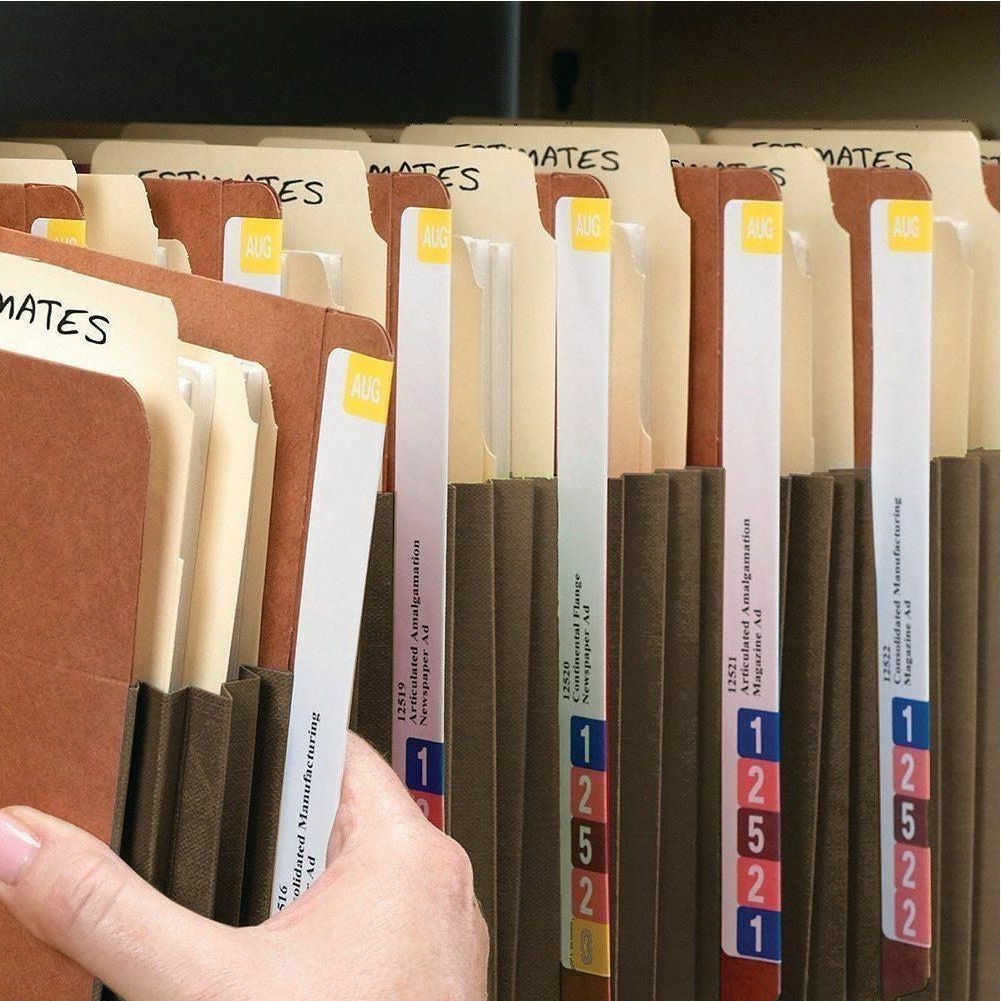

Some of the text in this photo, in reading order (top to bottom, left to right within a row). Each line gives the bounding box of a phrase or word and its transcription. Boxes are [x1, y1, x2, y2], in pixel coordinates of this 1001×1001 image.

[245, 235, 272, 259] AUG
[423, 226, 450, 249] AUG
[576, 214, 601, 237] AUG
[747, 217, 774, 239] AUG
[893, 216, 920, 238] AUG
[350, 372, 382, 405] AUG
[740, 518, 751, 695] Articulated Amalgamation
[892, 498, 902, 685] Consolidated Manufacturing
[409, 540, 421, 725] Articulated Amalgamation
[572, 573, 581, 703] Continental Flange
[582, 605, 591, 704] Newspaper Ad
[753, 609, 763, 697] Magazine Ad
[904, 600, 912, 686] Magazine Ad
[397, 682, 406, 721] 12519
[419, 625, 429, 727] Newspaper Ad
[727, 657, 737, 693] 12521
[297, 712, 320, 830] Manufacturing
[306, 855, 316, 880] Ad
